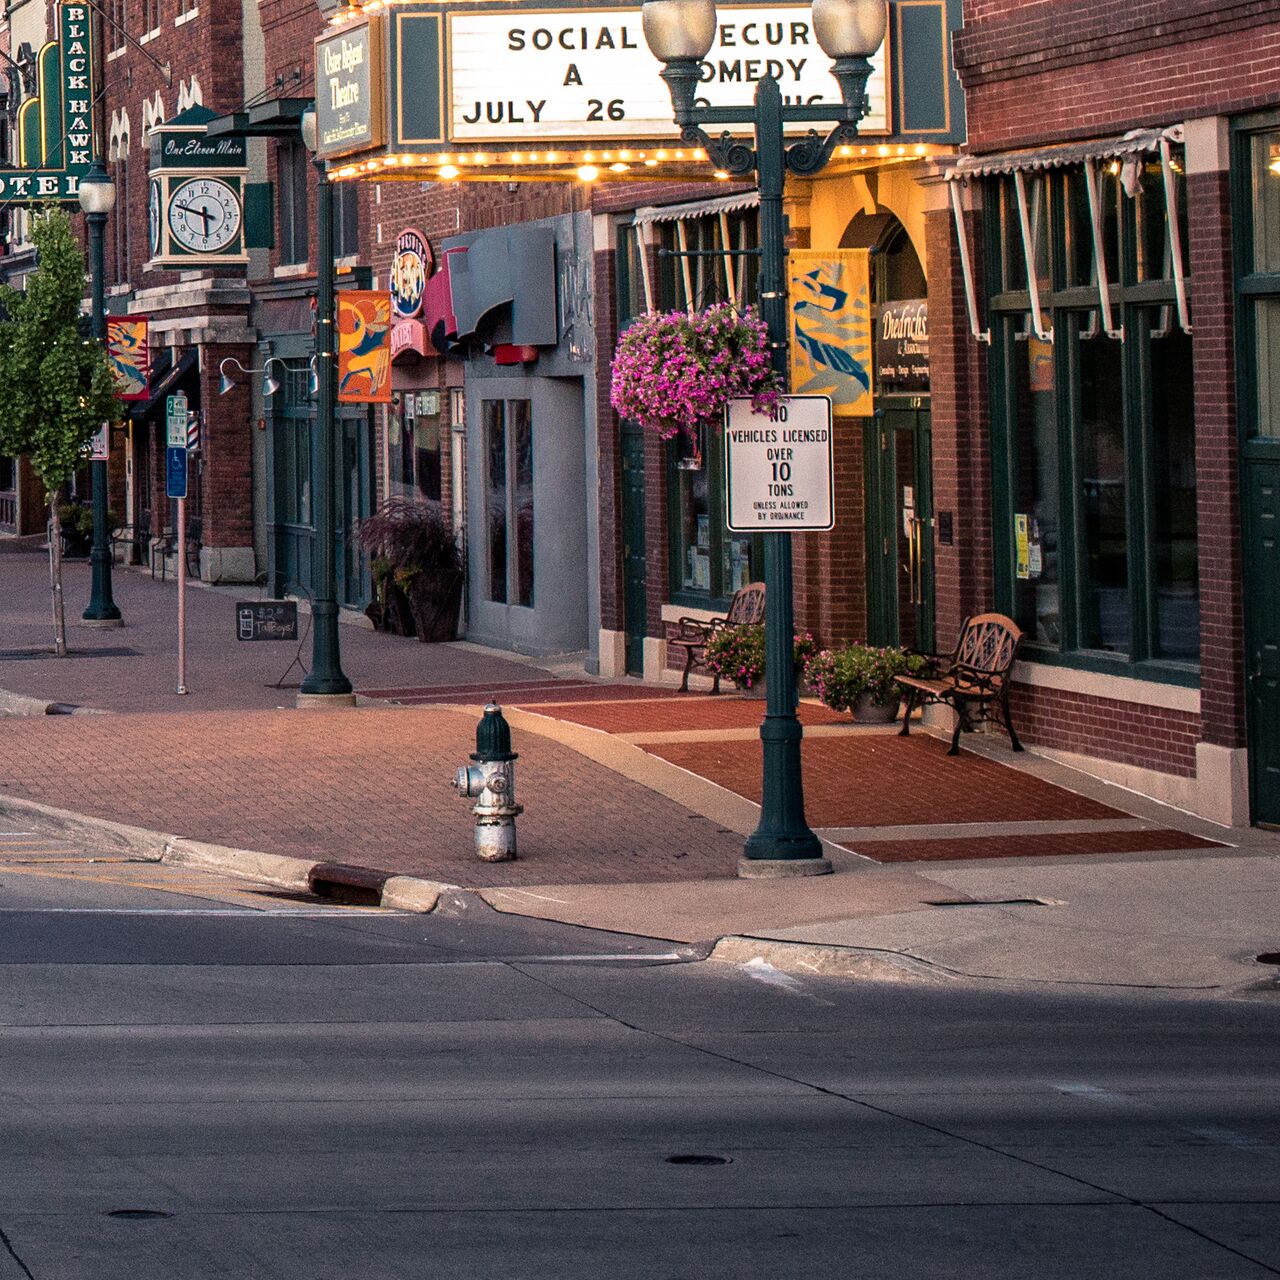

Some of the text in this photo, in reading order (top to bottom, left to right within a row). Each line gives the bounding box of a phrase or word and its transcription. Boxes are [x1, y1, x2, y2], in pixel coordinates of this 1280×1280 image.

[508, 21, 810, 51] SOCIAL ECUR
[324, 39, 363, 76] Oster Regent
[562, 58, 808, 86] A OMEDY
[67, 7, 91, 164] BLACK HAWK
[329, 77, 360, 111] Theatre
[462, 99, 626, 124] JULY 26
[164, 139, 242, 156] One Eleven Main
[882, 304, 928, 340] Diedrichs
[769, 405, 788, 422] NO
[731, 429, 828, 443] VEHICLES LICENSED
[767, 448, 793, 461] OVER
[771, 462, 792, 481] 10
[768, 484, 794, 497] TONS
[753, 501, 809, 510] UNLESS ALLOWED
[757, 511, 805, 521] BY ORDINANCE
